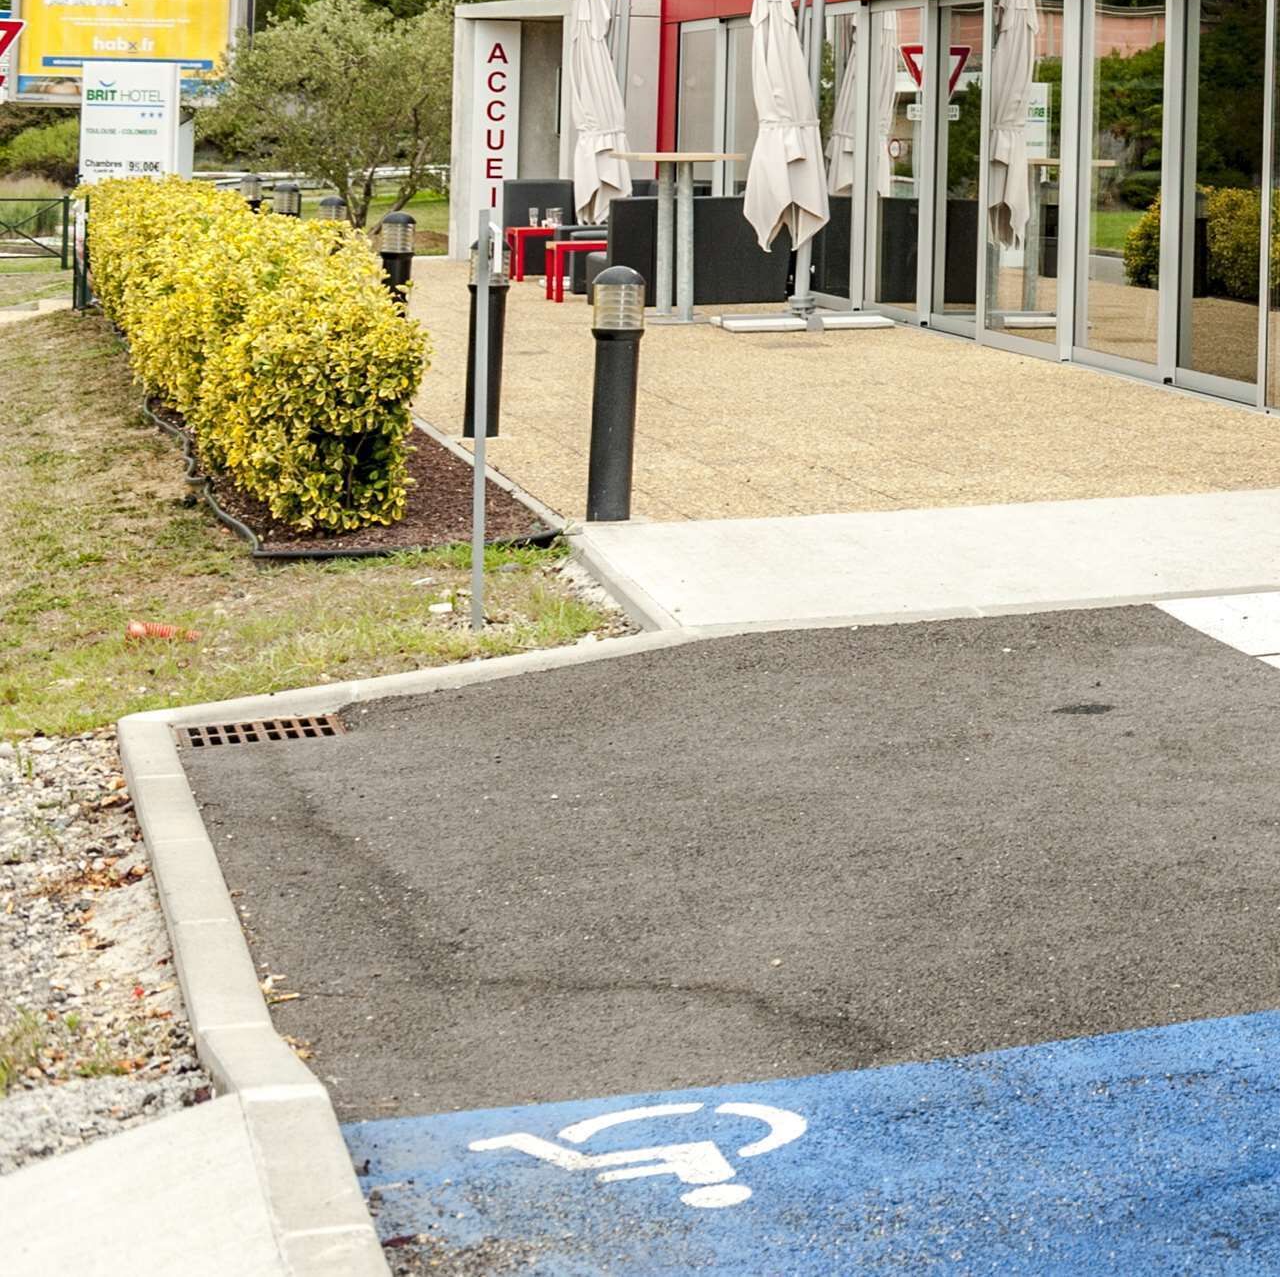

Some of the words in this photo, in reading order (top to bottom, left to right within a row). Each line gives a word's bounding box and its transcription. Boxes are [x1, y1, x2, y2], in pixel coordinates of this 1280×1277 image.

[86, 89, 117, 101] BRIT
[120, 89, 165, 103] HOTEL
[486, 42, 508, 208] ACCUEI
[85, 159, 122, 168] Chambres
